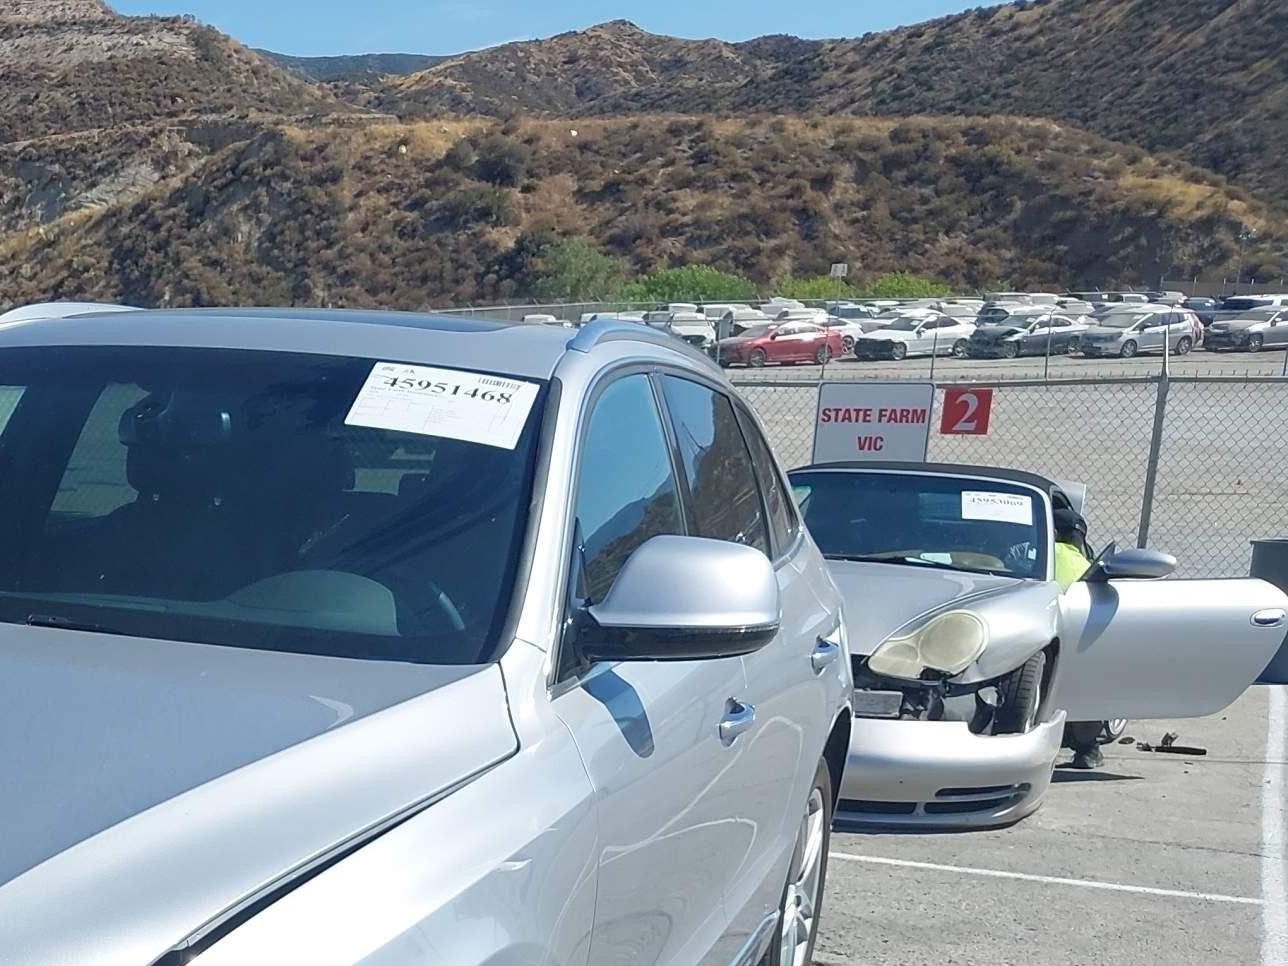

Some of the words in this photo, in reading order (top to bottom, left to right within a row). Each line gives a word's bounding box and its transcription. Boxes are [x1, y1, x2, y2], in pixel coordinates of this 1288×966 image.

[383, 377, 512, 404] 45951468
[821, 408, 872, 423] STATE
[877, 408, 927, 424] FARM
[952, 393, 979, 431] 2
[857, 436, 884, 451] VIC
